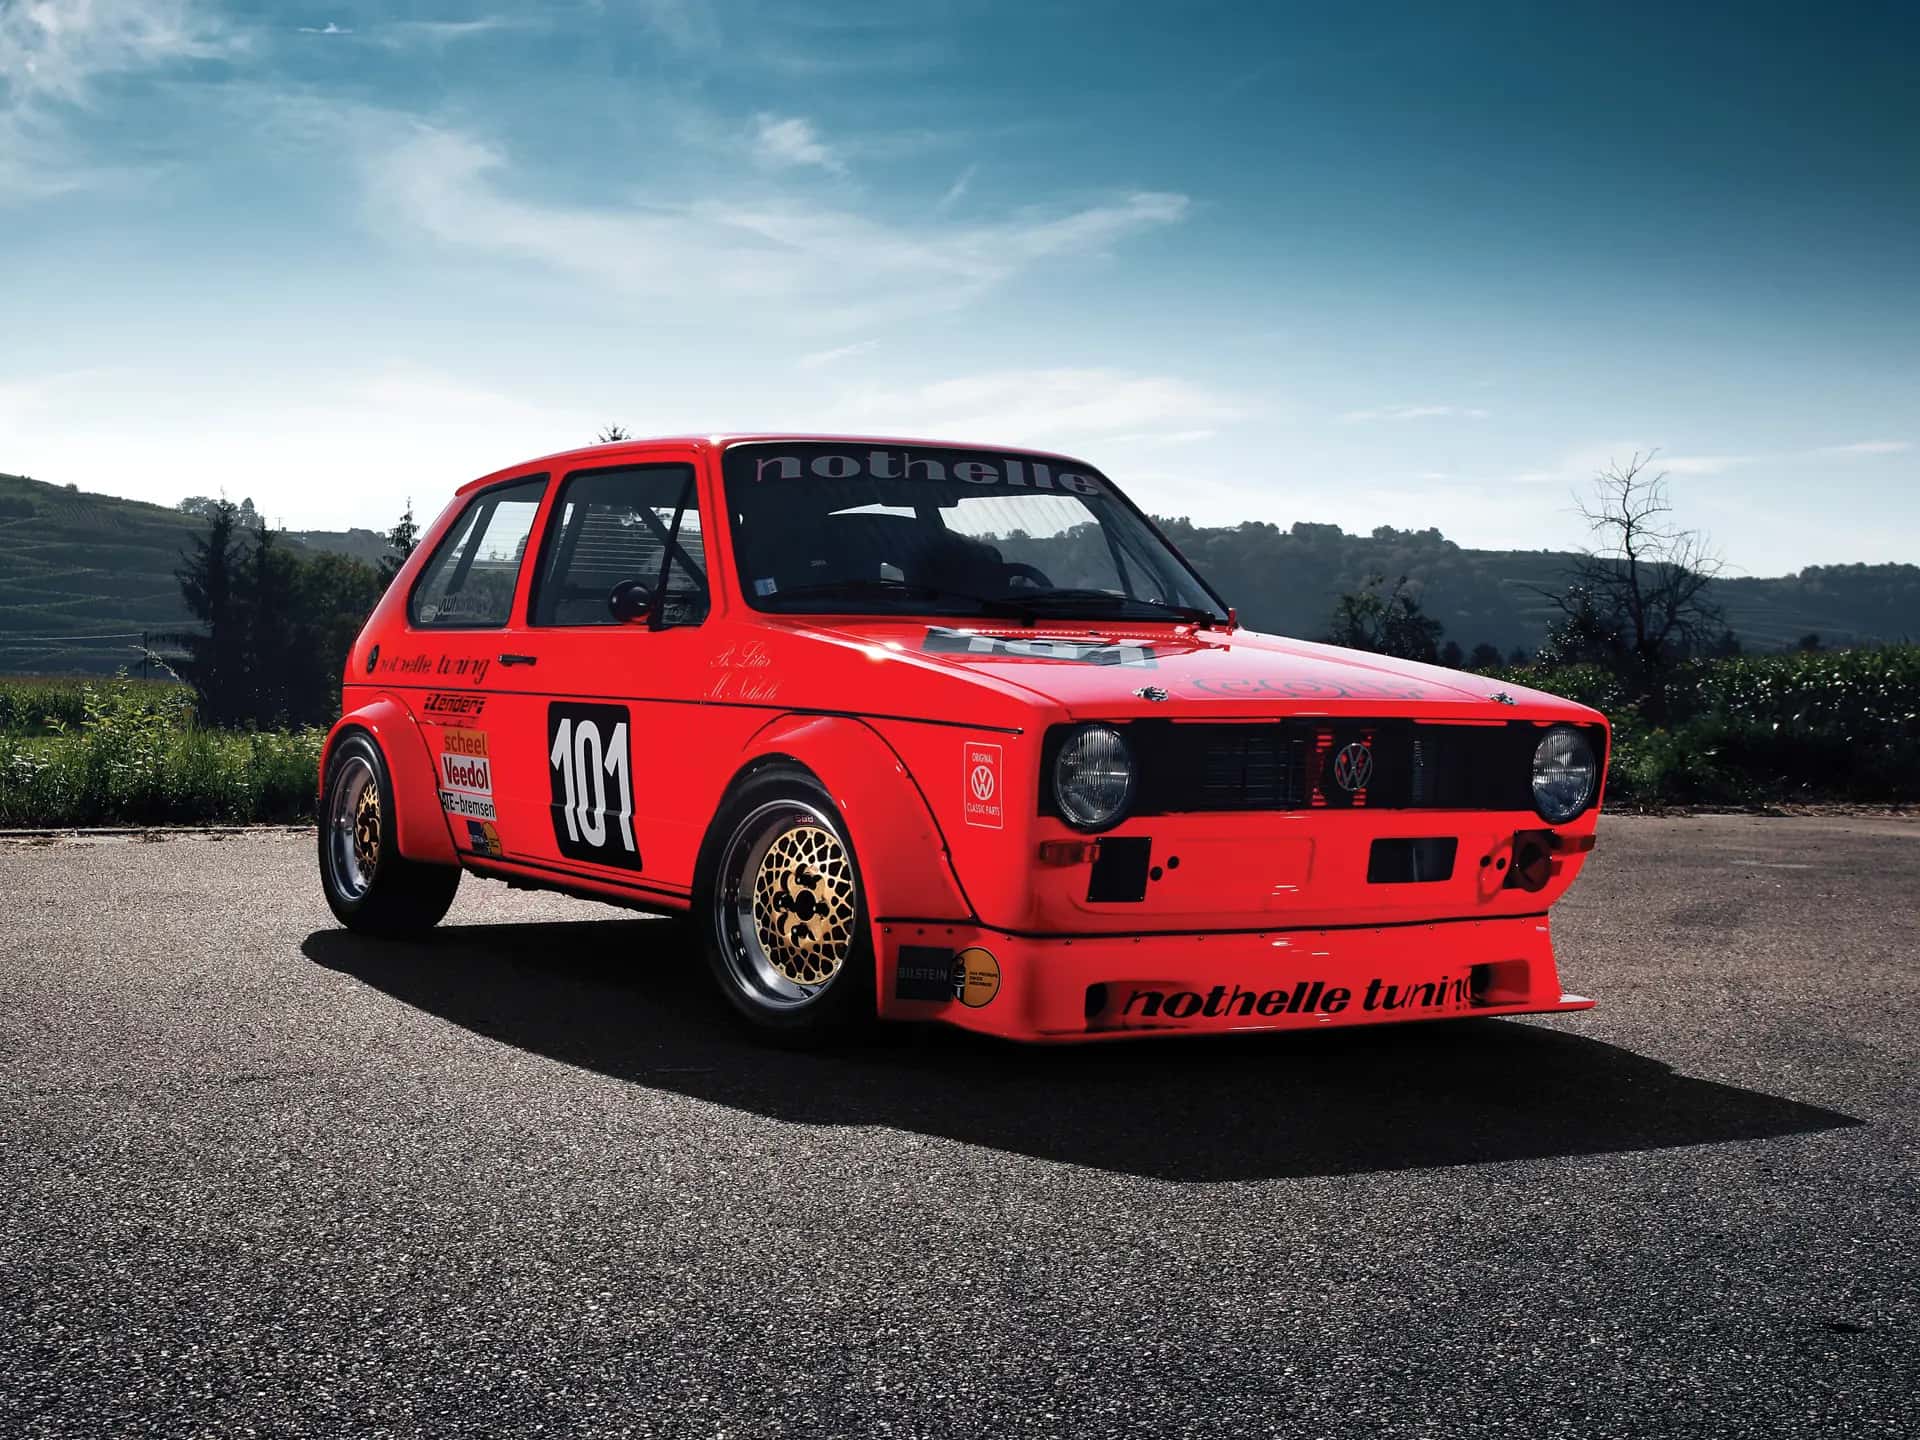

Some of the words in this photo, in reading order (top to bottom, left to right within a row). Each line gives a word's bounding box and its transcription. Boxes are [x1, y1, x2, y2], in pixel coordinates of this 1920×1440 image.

[756, 451, 1099, 495] nothelle
[444, 730, 487, 756] scheel
[442, 756, 489, 790] Veedol
[550, 718, 636, 852] 101
[897, 967, 948, 982] BILSTEIN
[1121, 980, 1352, 1019] nothelle
